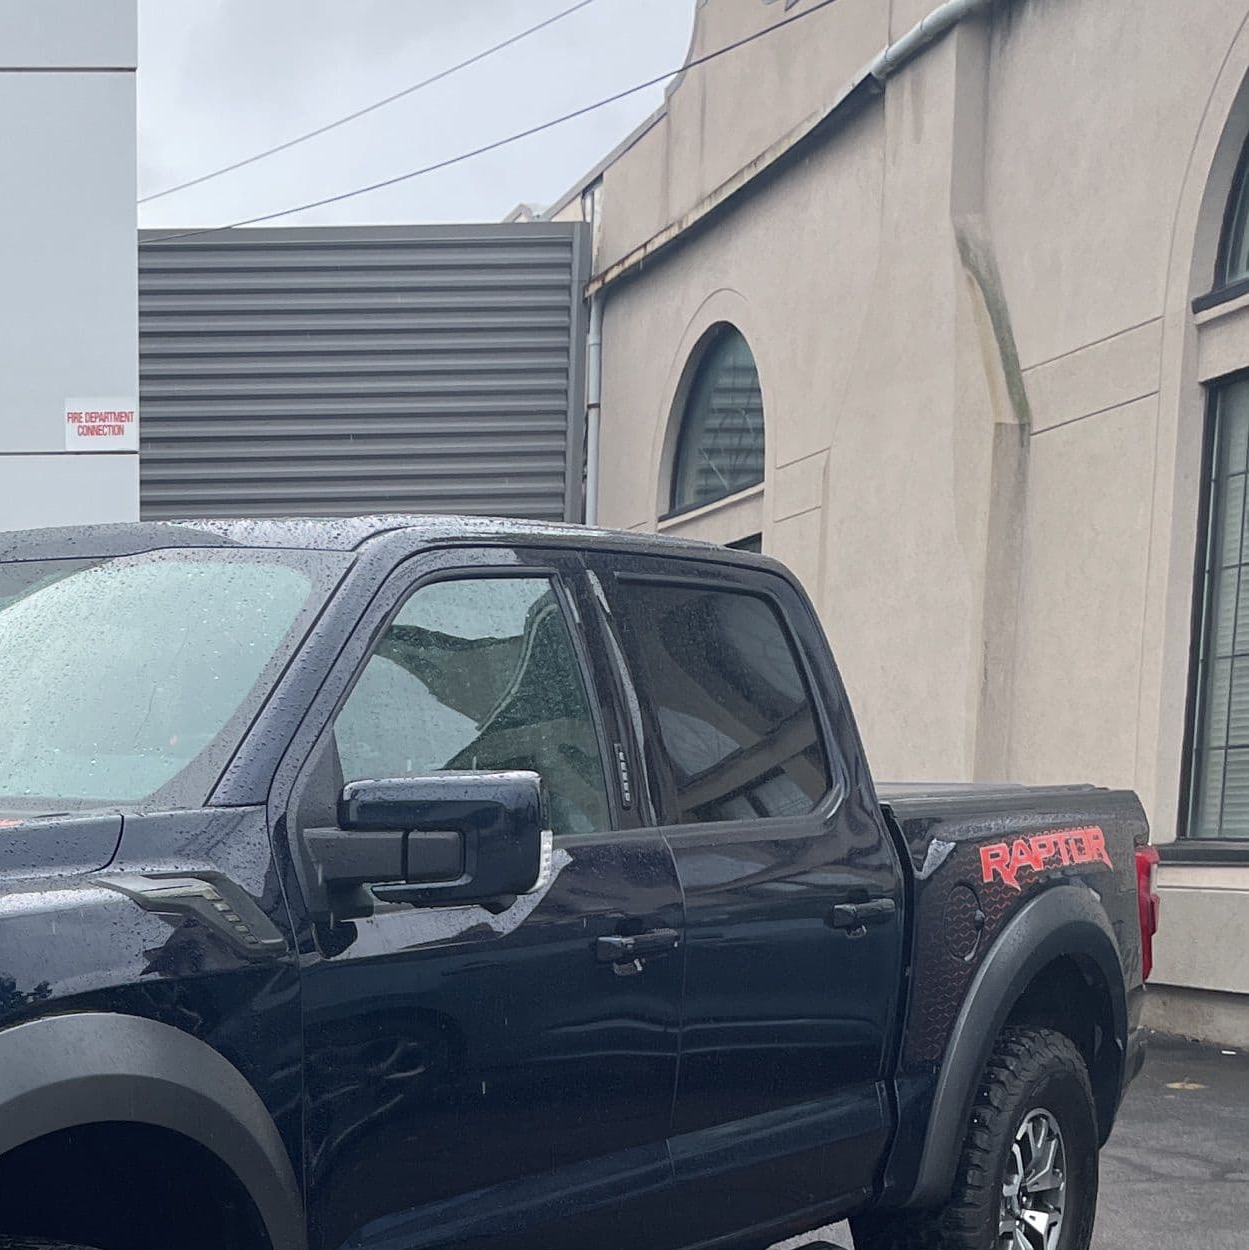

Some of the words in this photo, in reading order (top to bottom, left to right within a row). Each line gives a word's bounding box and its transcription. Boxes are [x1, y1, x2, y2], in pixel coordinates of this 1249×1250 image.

[67, 412, 83, 423] FIRE
[85, 411, 134, 423] DEPARTMENT
[77, 424, 125, 436] CONNECTION
[979, 826, 1114, 892] RAPTOR
